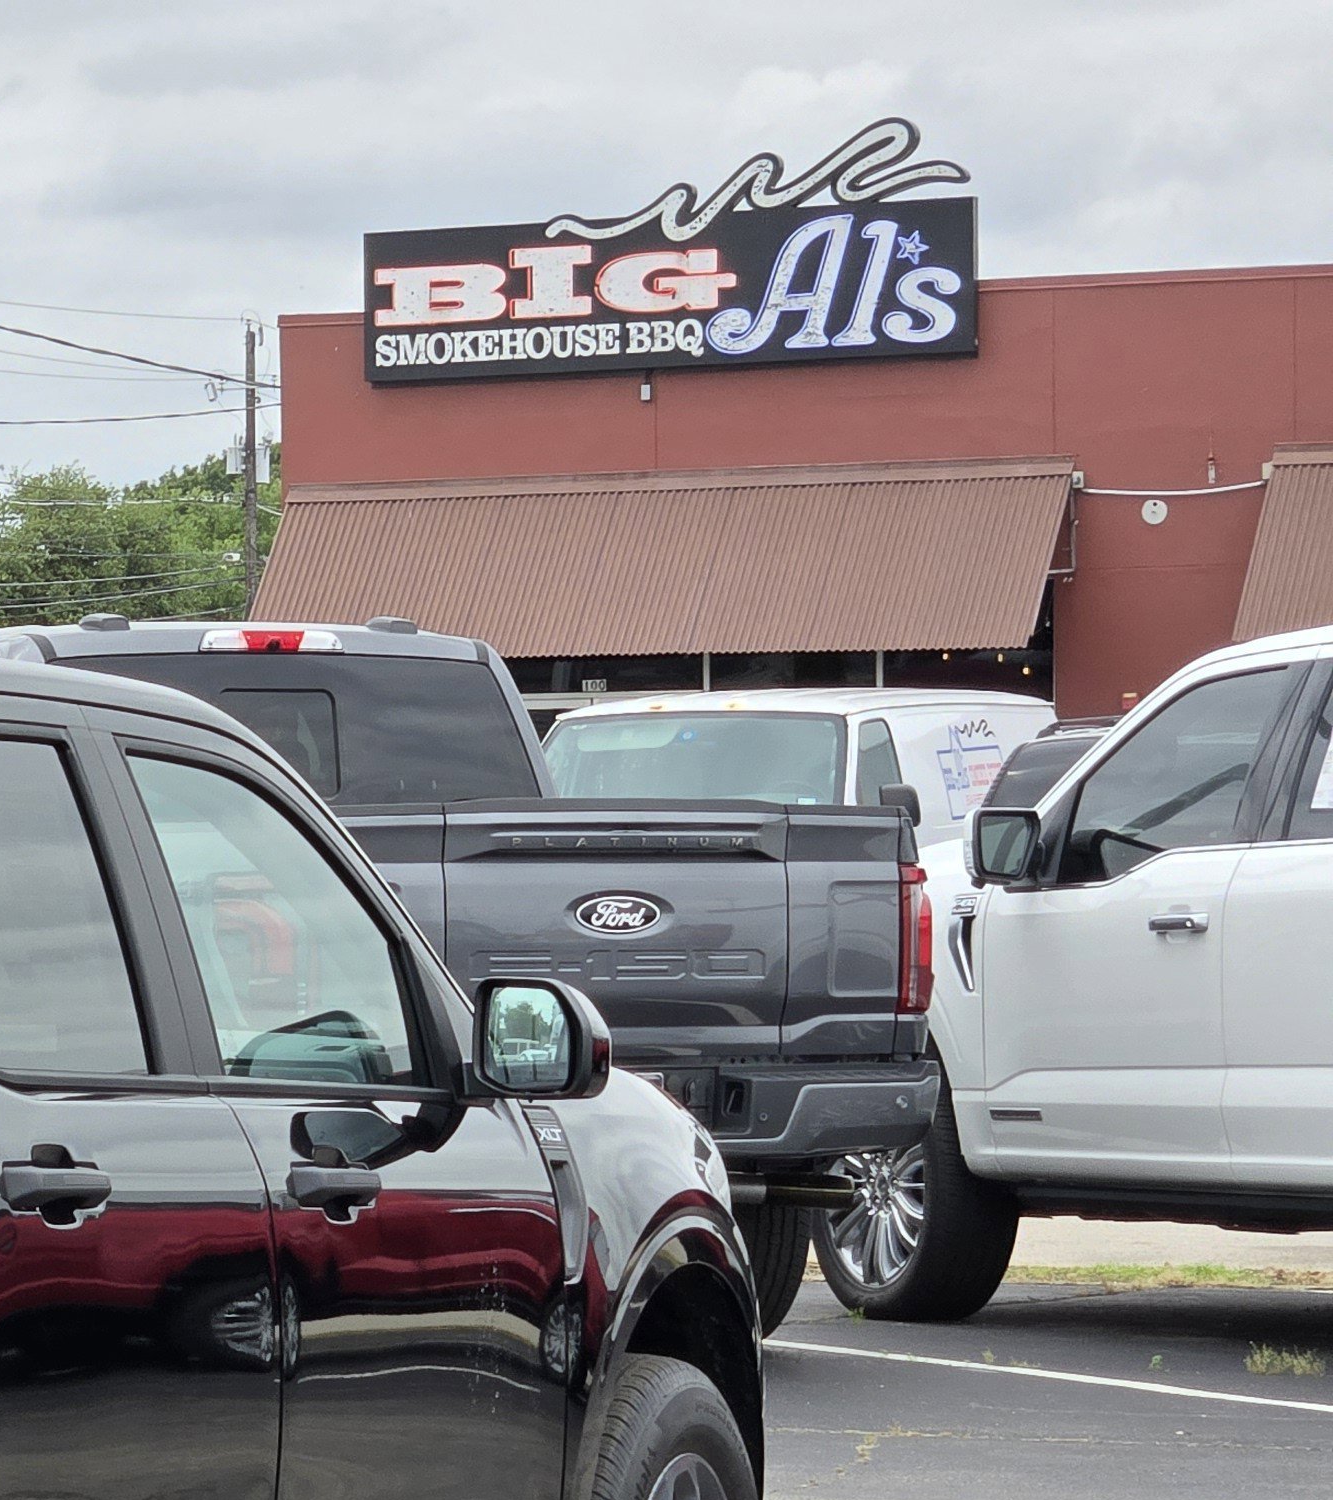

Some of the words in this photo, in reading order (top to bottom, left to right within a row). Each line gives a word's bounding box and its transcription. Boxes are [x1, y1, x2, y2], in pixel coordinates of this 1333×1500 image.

[374, 243, 737, 326] BIG
[375, 320, 620, 367] SMOKEHOUSE
[625, 318, 705, 357] BBQ
[584, 680, 605, 691] 100
[511, 836, 745, 848] PLATINUM
[590, 899, 646, 927] Ford
[469, 948, 766, 981] F-150
[537, 1128, 562, 1142] XLT
